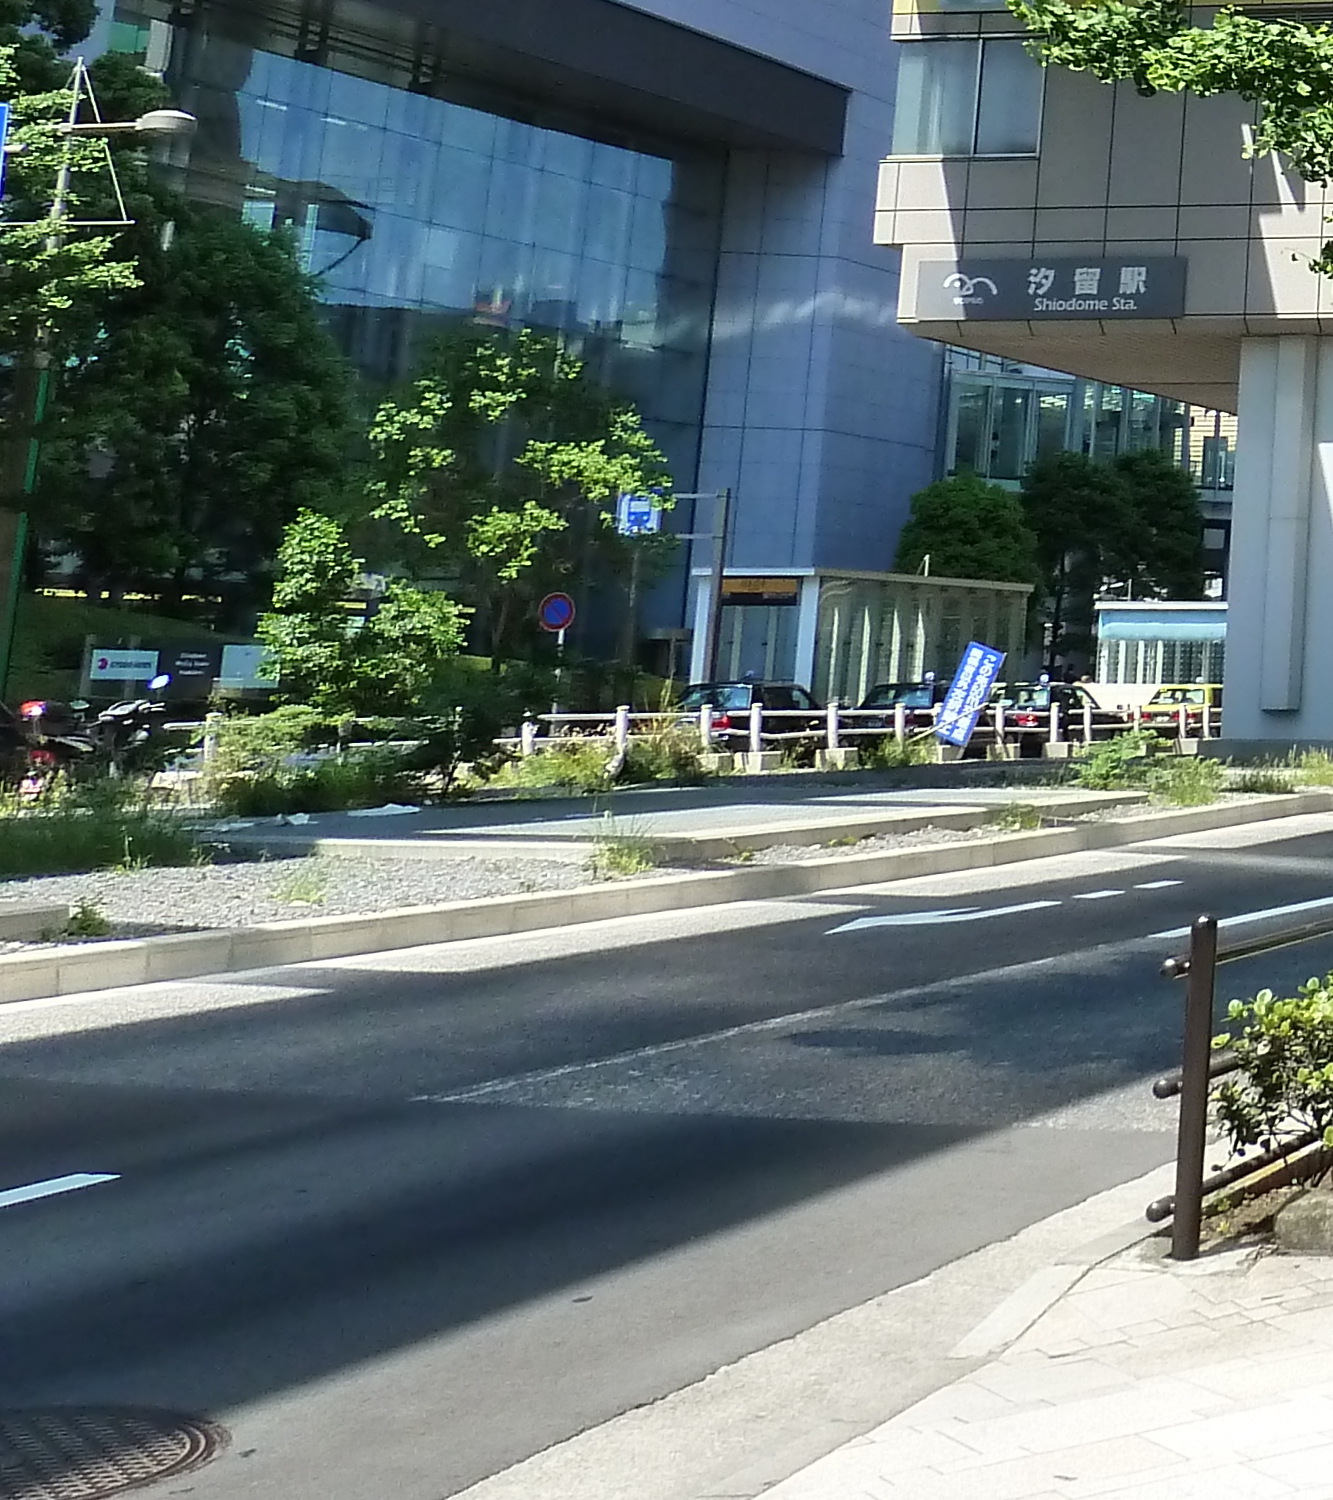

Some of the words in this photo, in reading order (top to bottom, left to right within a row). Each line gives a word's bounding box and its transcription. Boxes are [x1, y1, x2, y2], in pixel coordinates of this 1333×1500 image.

[1027, 266, 1147, 295] 汐留駅
[1033, 297, 1109, 312] Shiodome
[1111, 296, 1138, 311] Sta.
